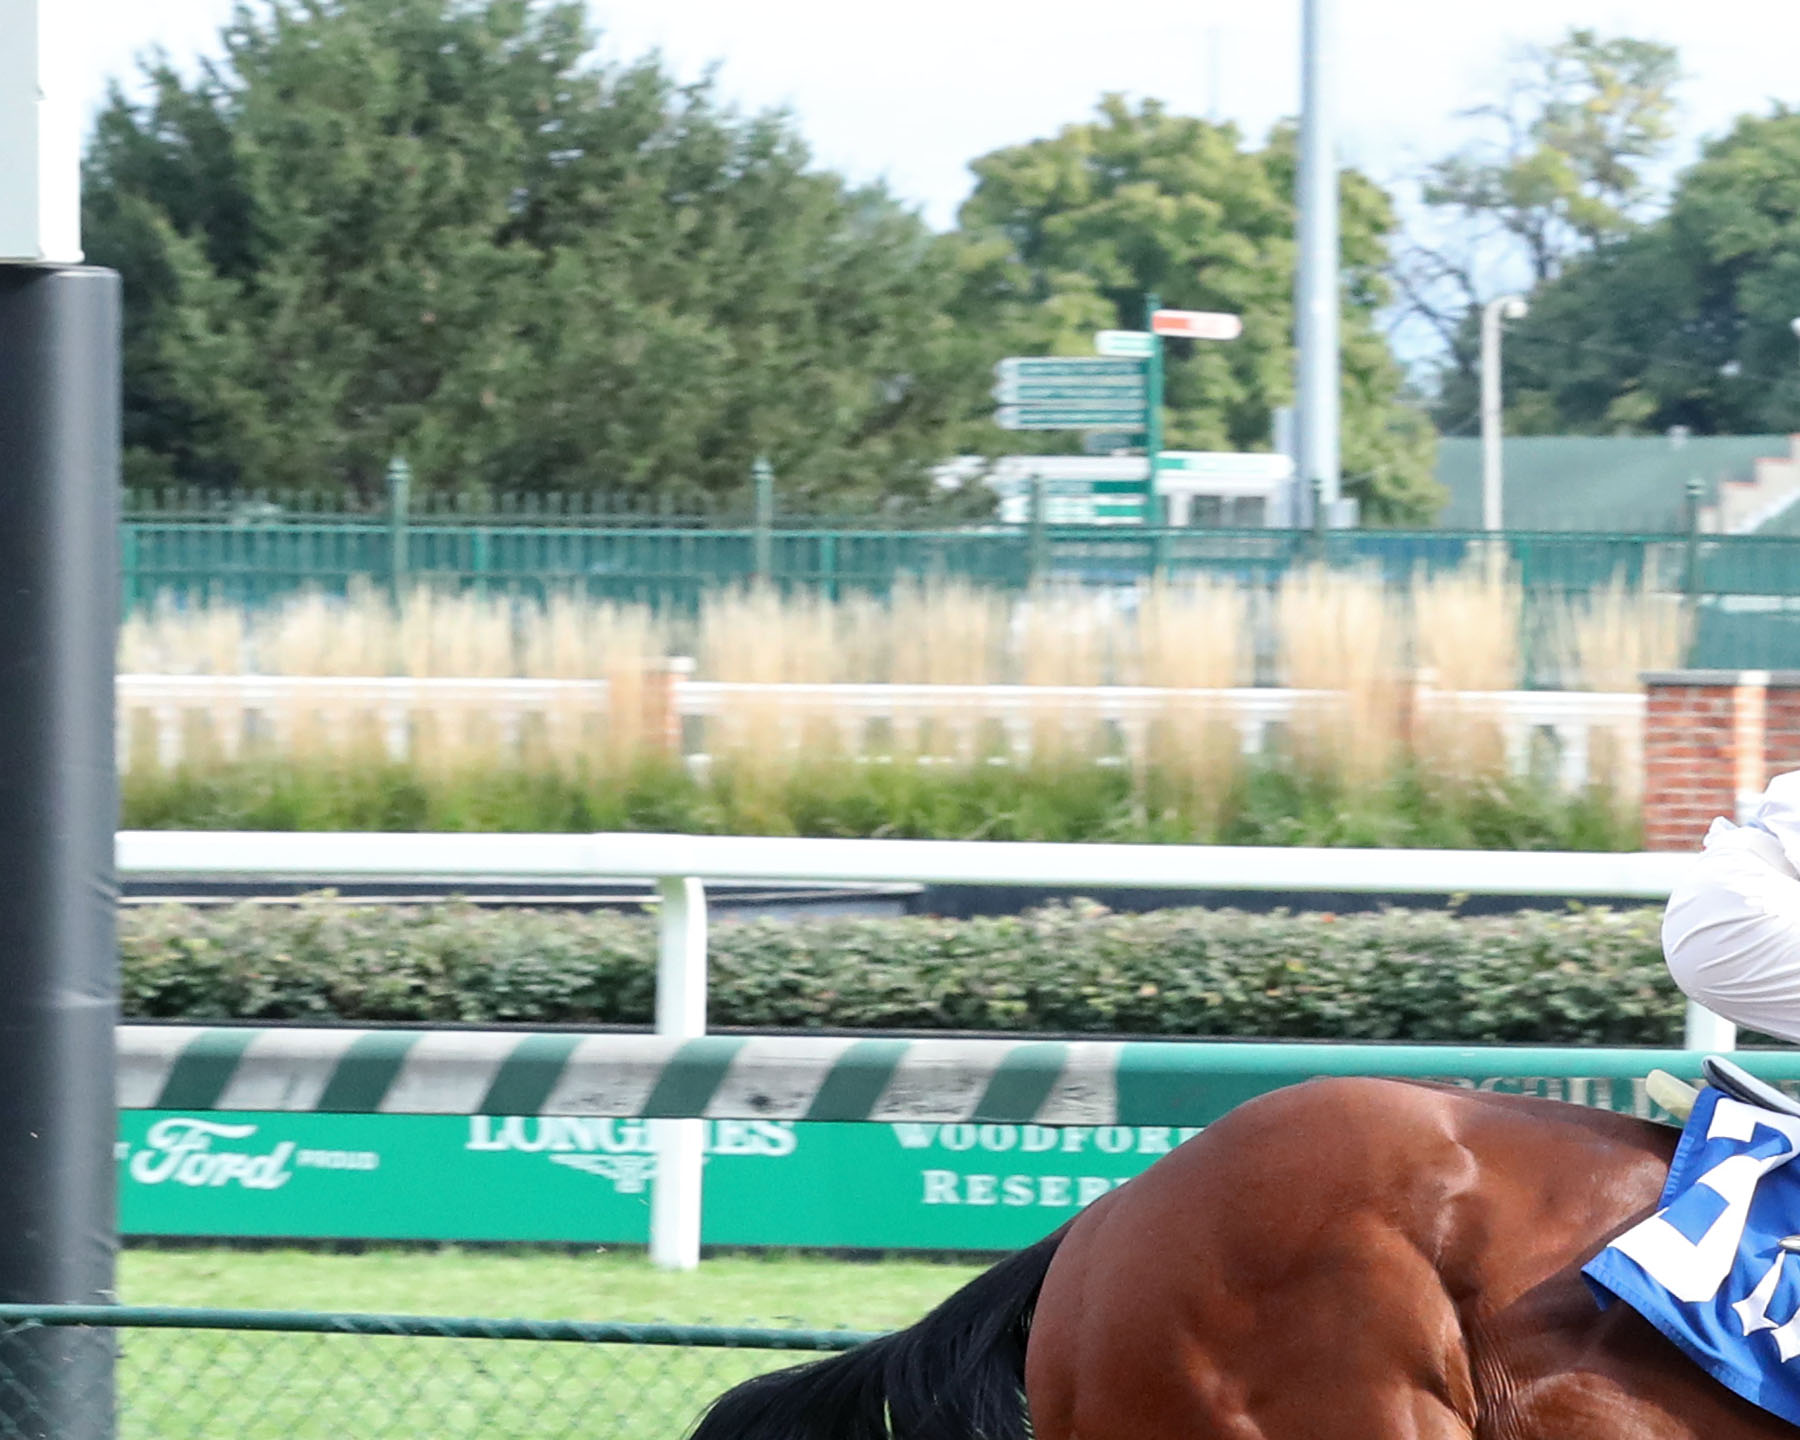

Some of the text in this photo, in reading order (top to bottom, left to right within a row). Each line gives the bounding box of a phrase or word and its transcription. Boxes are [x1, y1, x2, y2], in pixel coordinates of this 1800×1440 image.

[130, 1117, 296, 1190] Ford
[464, 1116, 799, 1157] LONGES
[920, 1169, 1132, 1207] RESER
